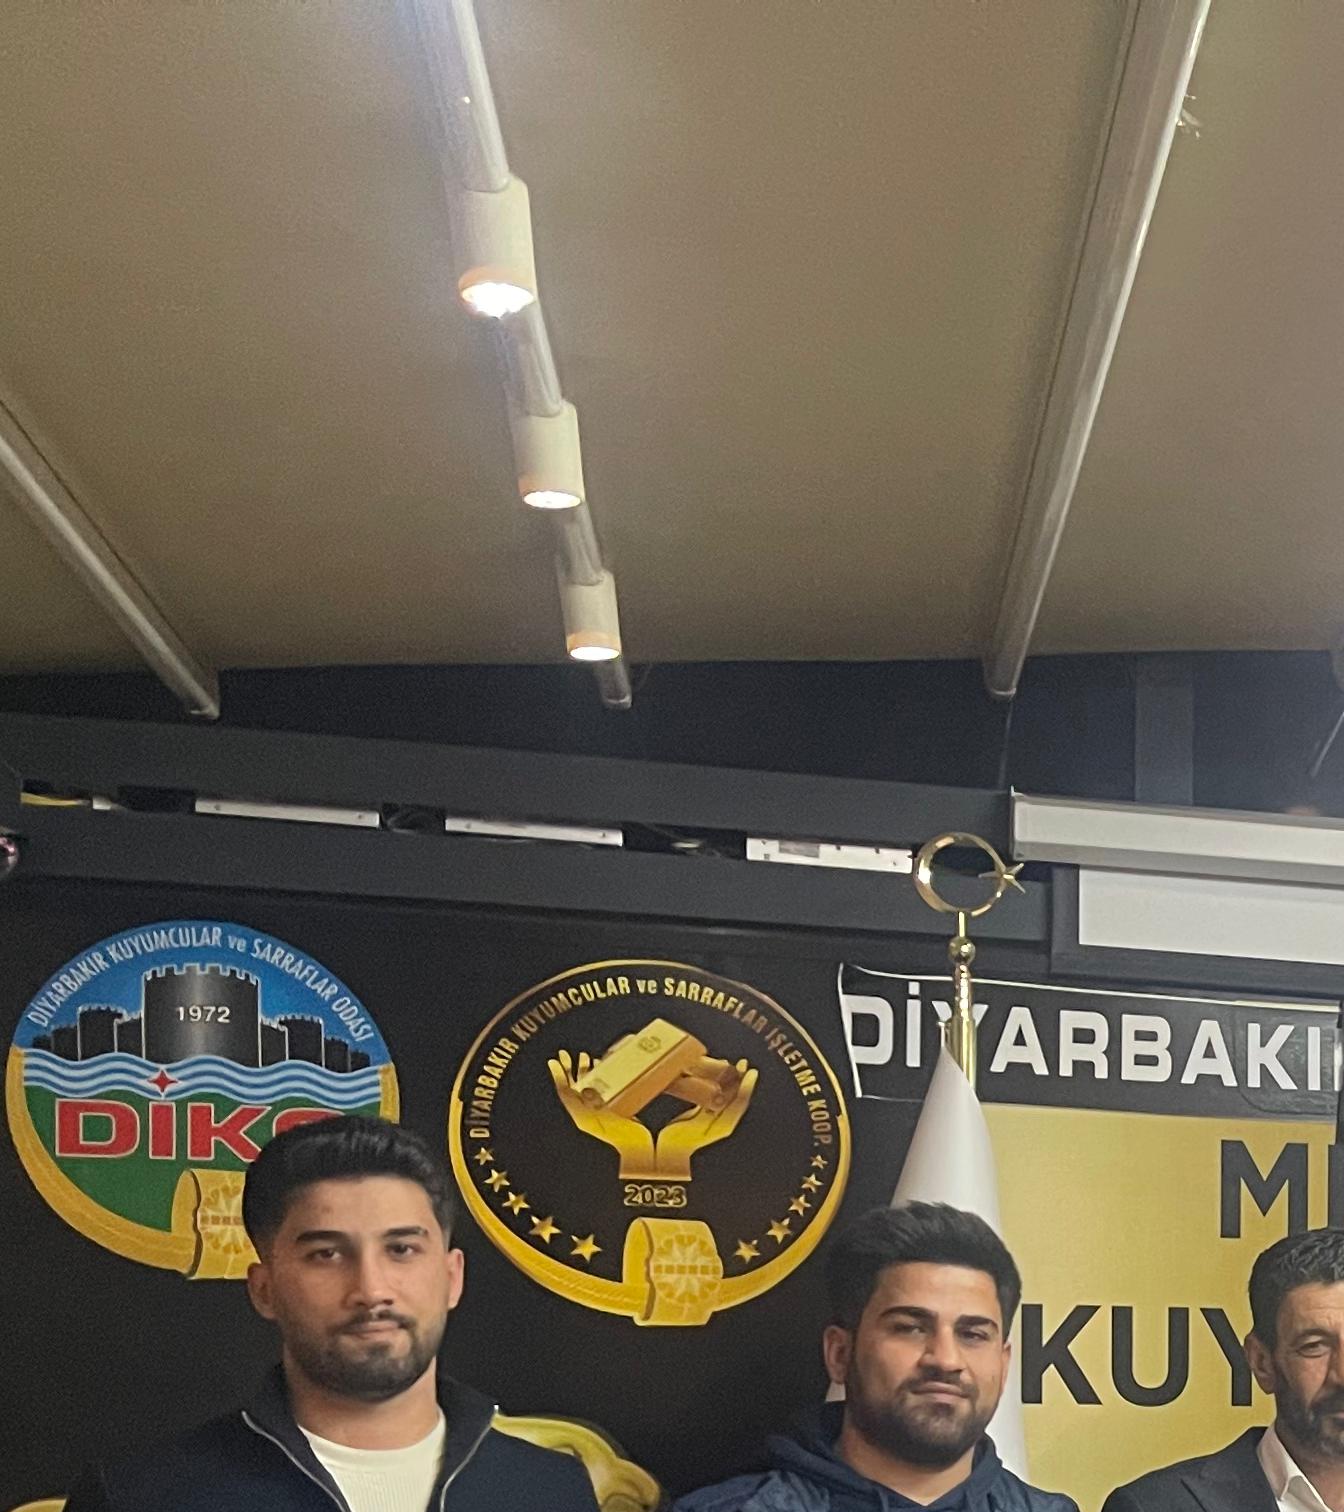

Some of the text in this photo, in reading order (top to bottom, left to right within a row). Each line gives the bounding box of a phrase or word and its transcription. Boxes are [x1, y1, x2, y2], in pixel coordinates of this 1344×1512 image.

[106, 926, 224, 964] KUYUMCULAR
[227, 935, 246, 953] ve
[250, 938, 340, 1002] SARRAFLAR
[331, 996, 375, 1042] ODASI
[176, 1005, 232, 1024] 1972
[511, 975, 632, 1042] KUYUMCULAR
[636, 979, 658, 994] ve
[663, 977, 769, 1034] SARRAFLAR
[623, 1184, 688, 1208] 2023
